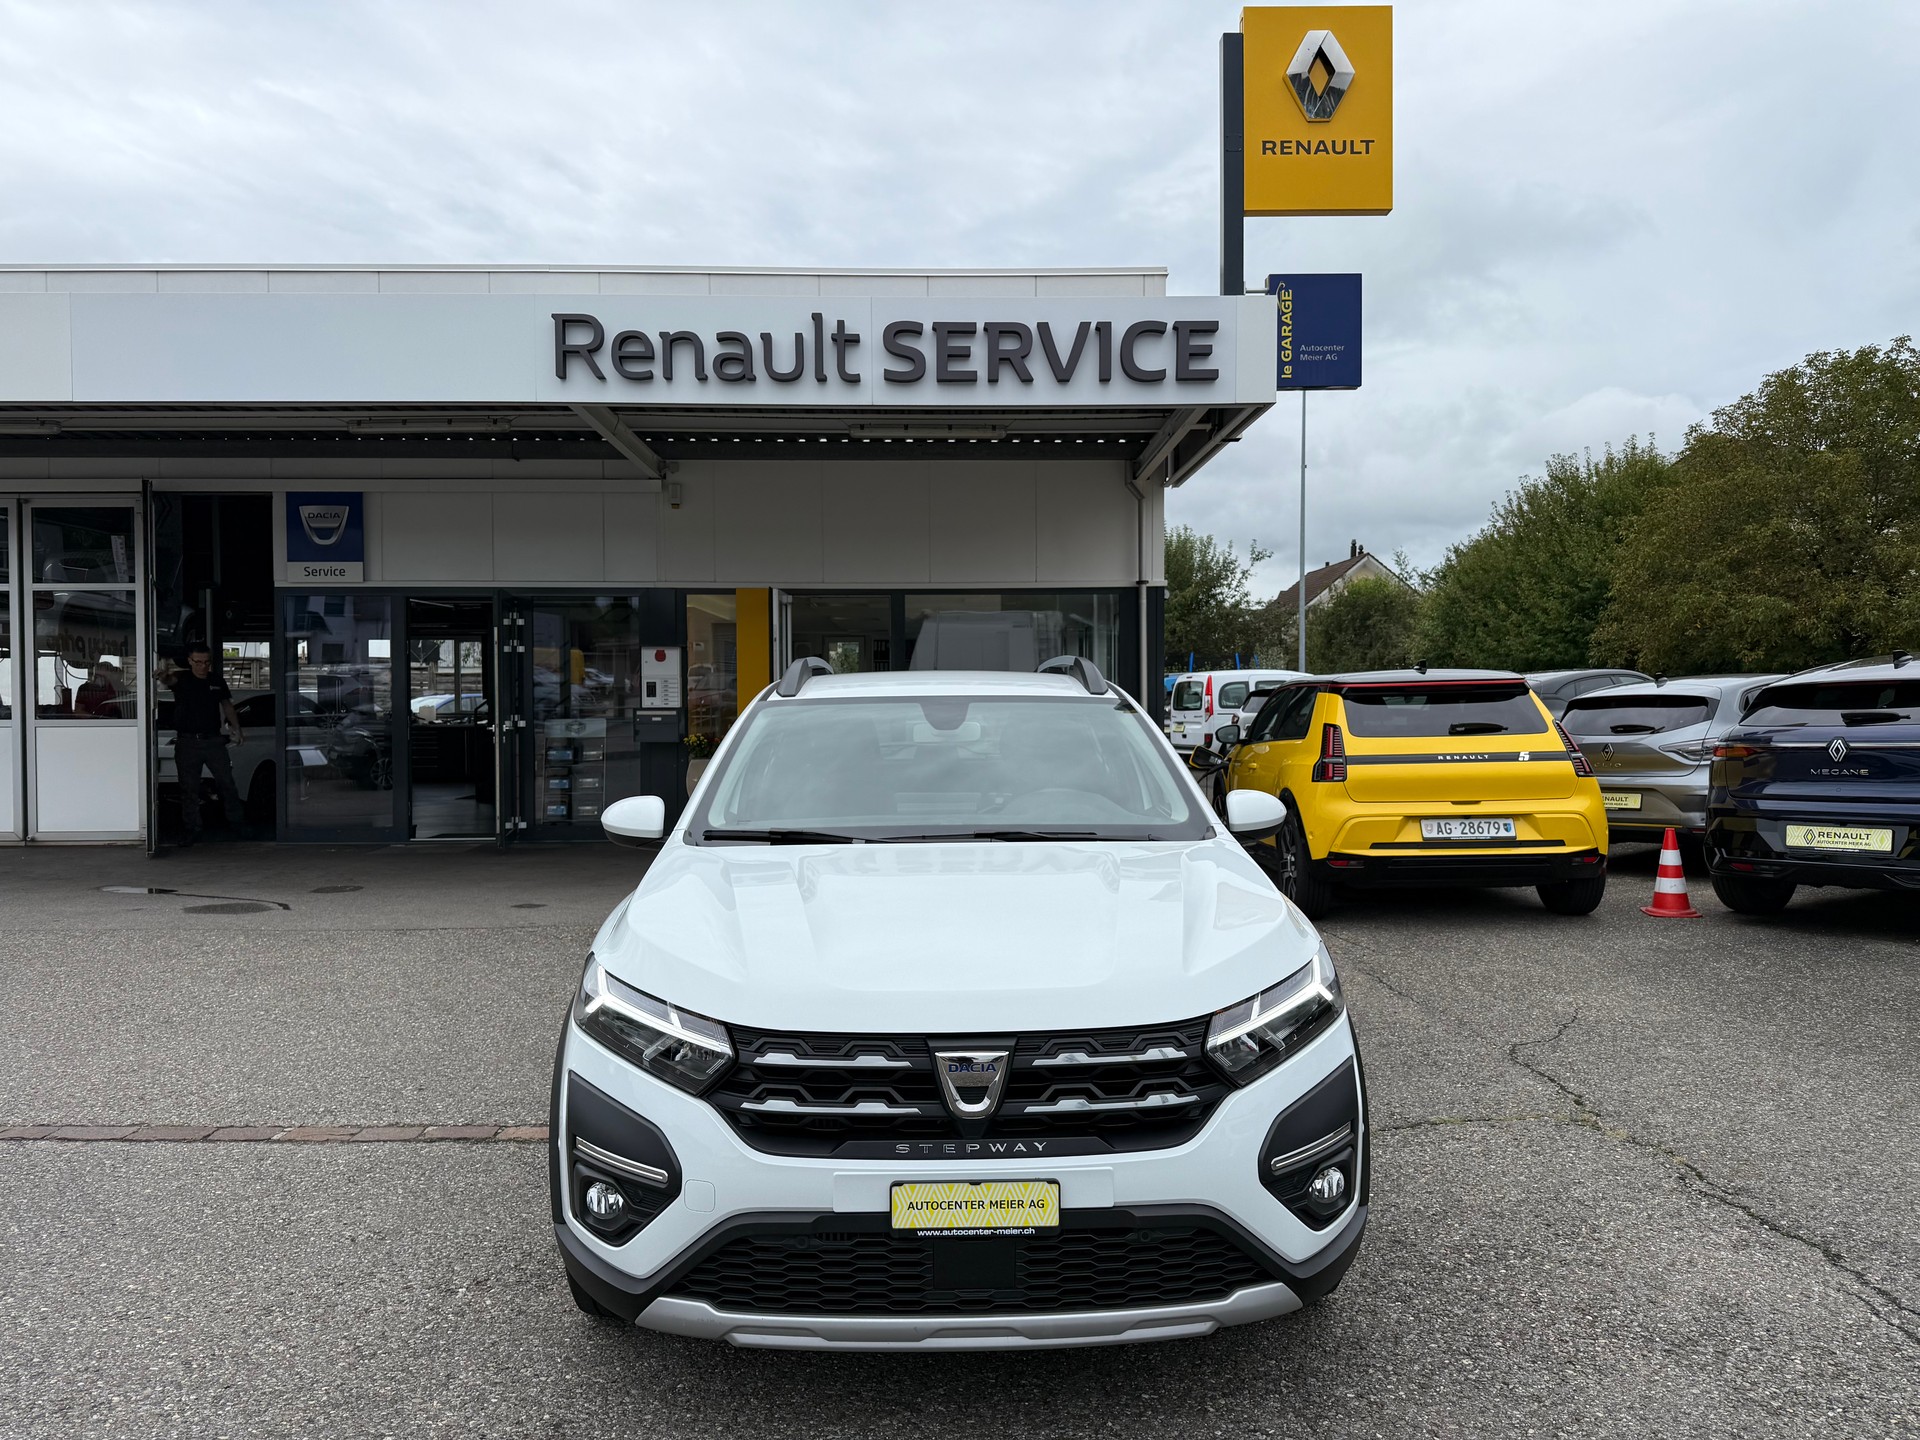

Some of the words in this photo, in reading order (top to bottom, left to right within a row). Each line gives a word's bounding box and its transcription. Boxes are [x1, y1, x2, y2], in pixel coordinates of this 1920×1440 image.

[1261, 139, 1375, 155] RENAULT
[1281, 289, 1293, 362] GARAGE
[551, 312, 861, 384] Renault
[882, 320, 1221, 384] SERVICE
[1300, 343, 1345, 352] Autocenter
[1325, 353, 1338, 361] AG
[1281, 366, 1293, 379] le
[304, 566, 346, 577] Service
[1518, 751, 1530, 761] 5
[1810, 768, 1869, 776] MEGANE
[1818, 831, 1871, 841] RENAULT
[949, 1063, 996, 1073] DACIA
[895, 1142, 1047, 1154] STEPWAY
[907, 1201, 986, 1211] AUTOCENTER
[989, 1199, 1025, 1210] MEIER
[1029, 1199, 1045, 1208] AG
[917, 1228, 1036, 1237] www.autocenter-meier.ch
